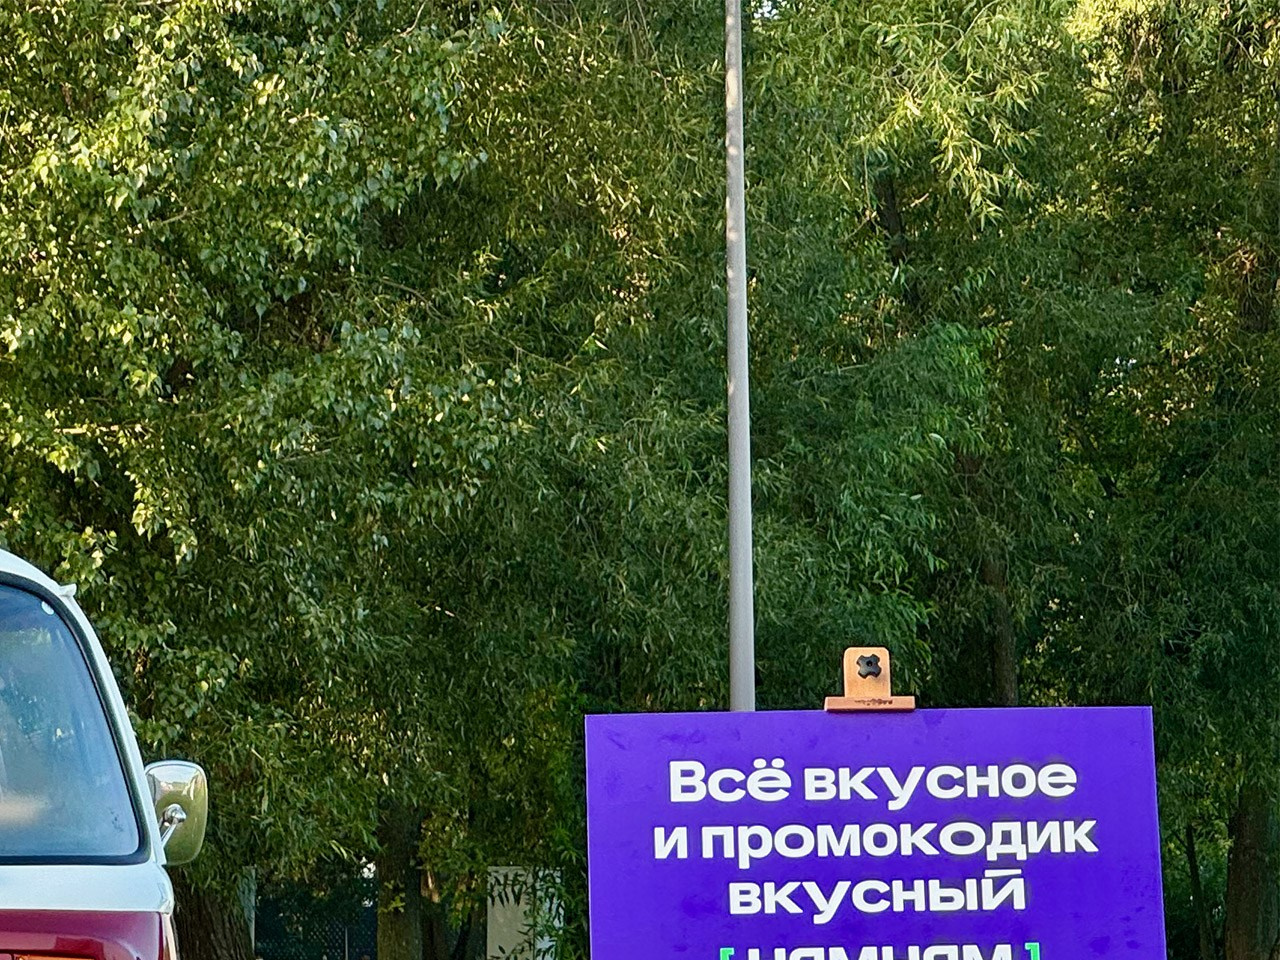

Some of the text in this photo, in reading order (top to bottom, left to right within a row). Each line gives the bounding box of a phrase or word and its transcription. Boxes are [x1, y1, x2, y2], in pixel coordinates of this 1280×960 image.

[669, 757, 1078, 810] Всё вкусное
[654, 818, 1099, 869] и промокодик
[729, 868, 1026, 924] вкусный
